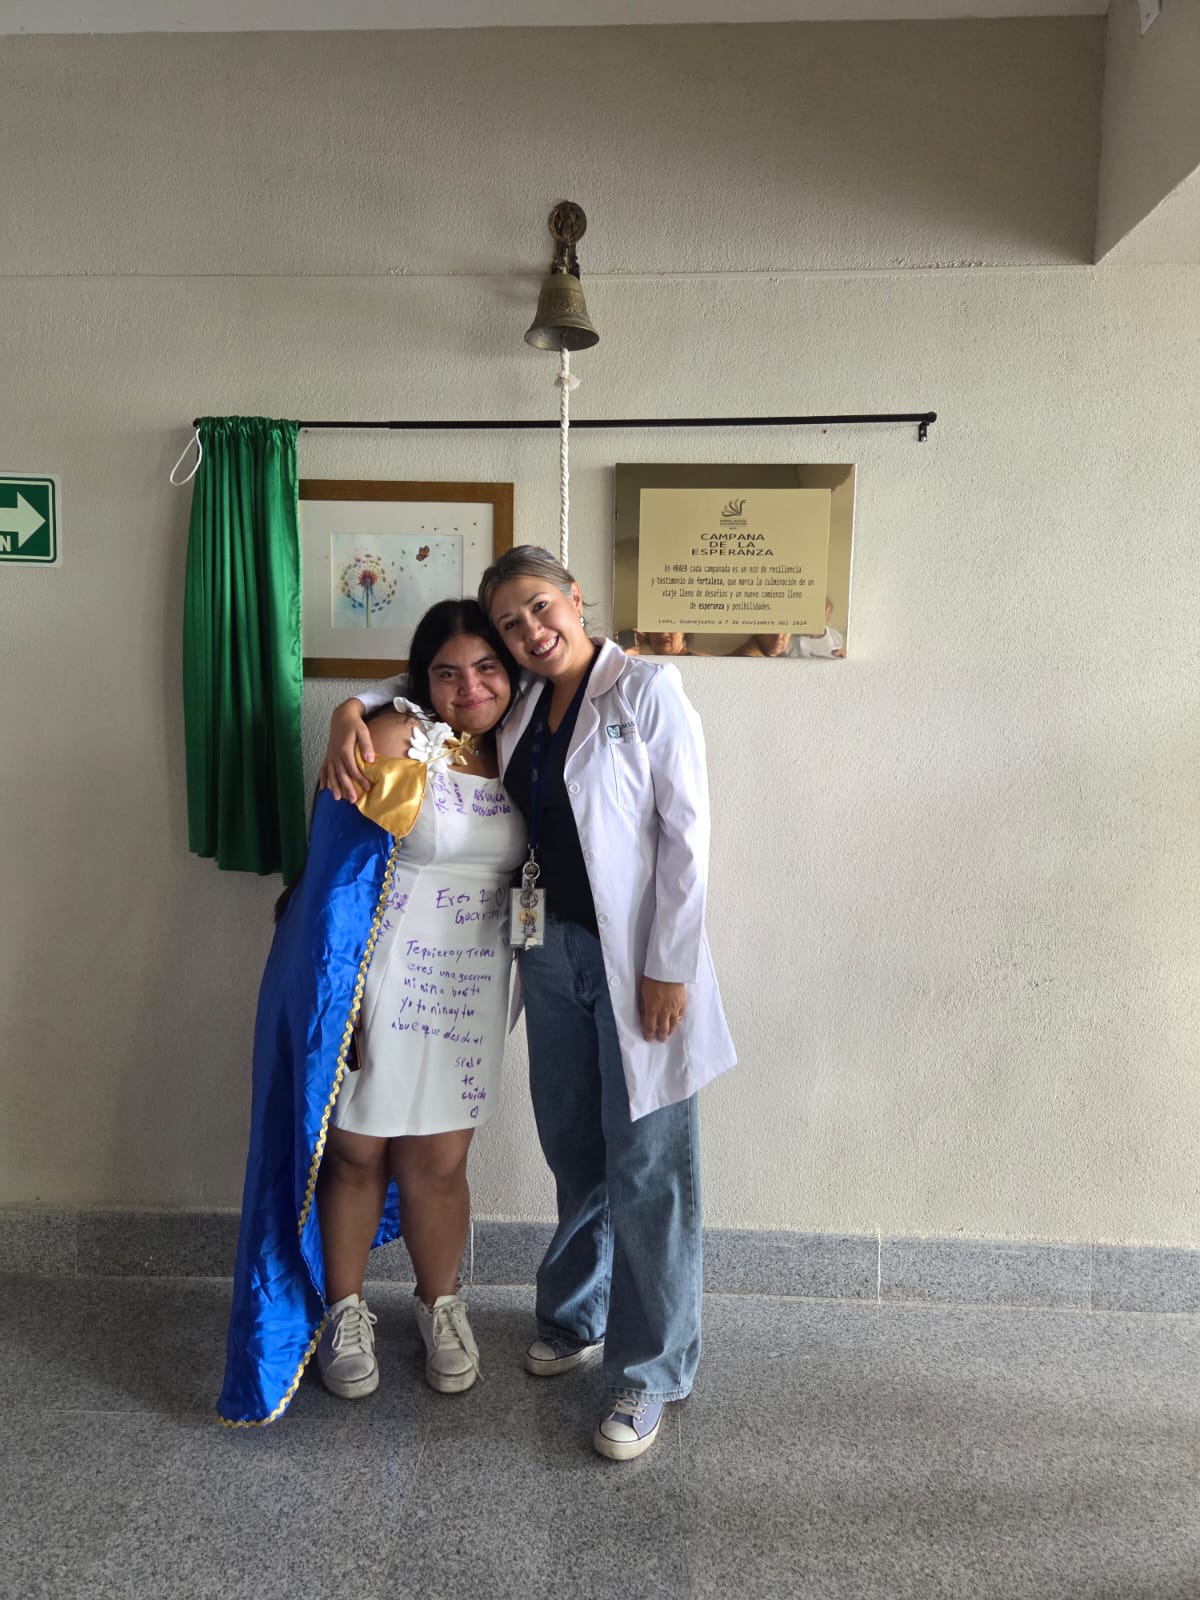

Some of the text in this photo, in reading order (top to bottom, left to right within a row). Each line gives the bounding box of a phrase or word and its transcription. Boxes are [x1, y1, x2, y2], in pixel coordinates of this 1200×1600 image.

[700, 533, 765, 541] CAMPANA
[689, 564, 702, 573] cada
[704, 565, 731, 574] campanada
[761, 565, 767, 573] de
[769, 565, 802, 573] resiliencia
[651, 578, 655, 587] y
[657, 577, 686, 585] testimonio
[688, 577, 694, 585] de
[696, 576, 725, 586] fortaleza,
[756, 577, 762, 586] la
[662, 588, 677, 599] viaje
[679, 588, 694, 597] lleno
[696, 589, 703, 597] de
[729, 591, 733, 599] y
[761, 589, 785, 598] comienzo
[787, 589, 803, 598] lleno
[690, 601, 696, 610] de
[698, 603, 725, 611] esperanza
